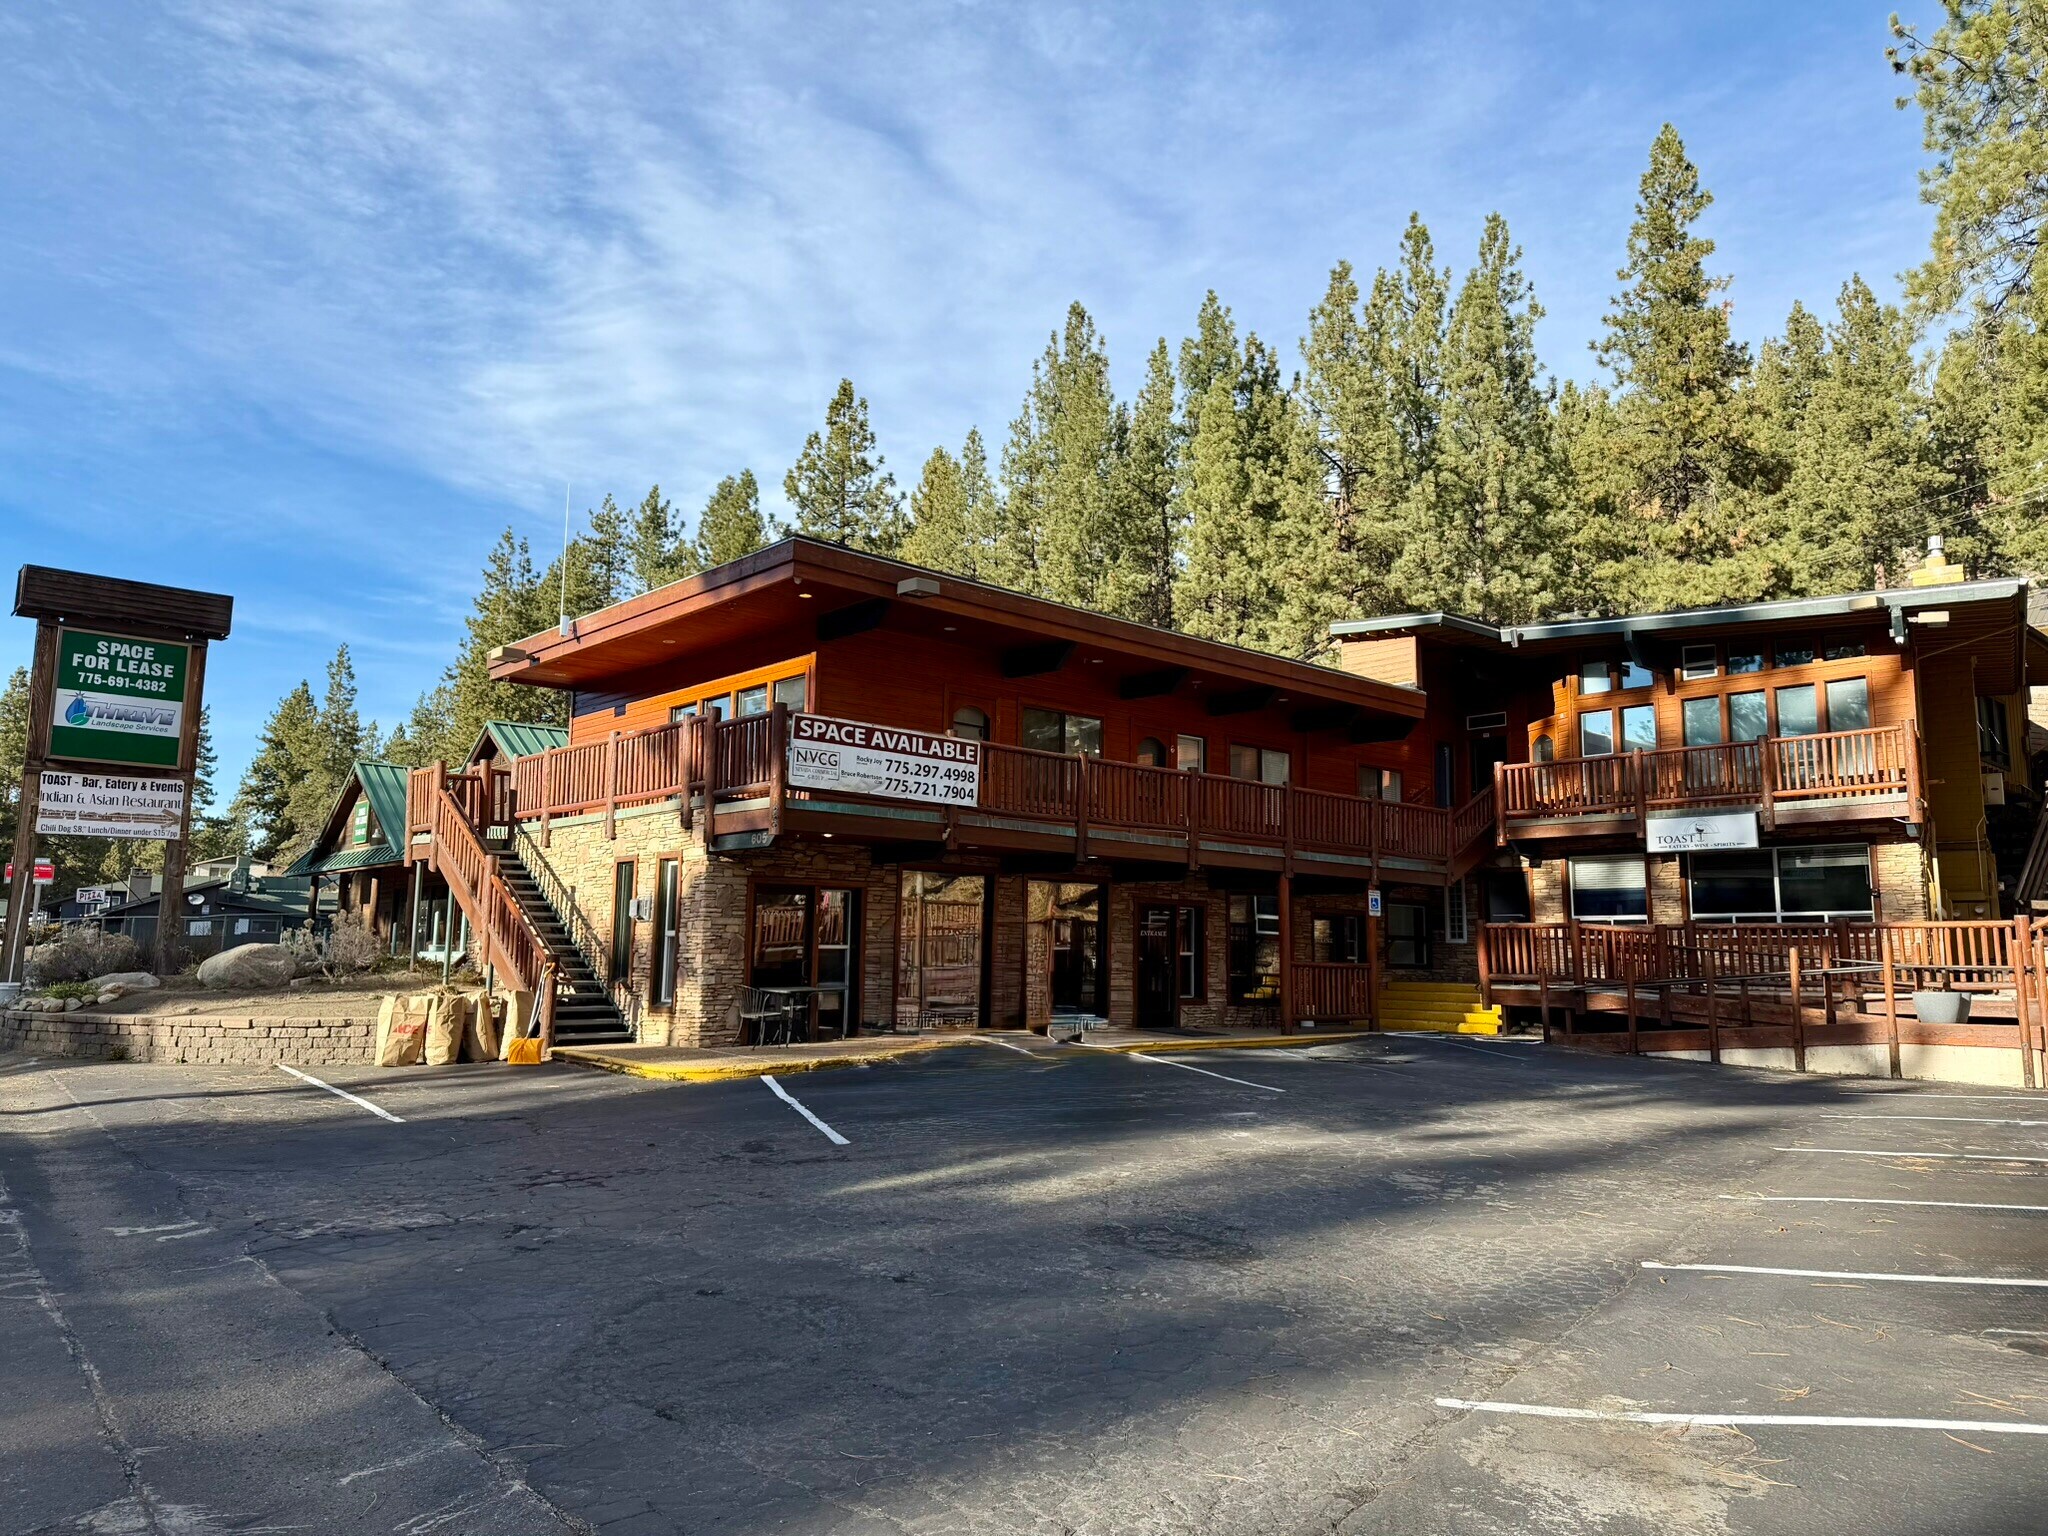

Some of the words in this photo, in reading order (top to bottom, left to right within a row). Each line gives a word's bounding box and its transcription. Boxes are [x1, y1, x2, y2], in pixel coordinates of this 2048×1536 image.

[97, 641, 155, 660] SPACE
[72, 653, 109, 670] FOR
[117, 659, 174, 678] LEASE
[78, 672, 167, 692] 775-691-4382
[85, 701, 176, 726] THRIVE
[91, 720, 134, 730] Landscape
[136, 724, 169, 733] Services
[799, 719, 866, 745] SPACE
[871, 730, 975, 761] AVAILABLE
[796, 749, 838, 767] NVCG
[857, 755, 872, 764] Rocky
[841, 769, 856, 777] Bruce
[857, 772, 883, 780] Robertson
[885, 759, 975, 783] 775.297.4998
[42, 774, 72, 786] TOAST
[82, 776, 102, 789] Bar,
[105, 778, 138, 791] Eatery
[140, 781, 147, 791] &
[150, 781, 184, 793] Events
[885, 777, 975, 800] 775.721.7904
[40, 790, 74, 803] Indian
[76, 792, 86, 805] &
[90, 793, 119, 806] Asian
[122, 795, 182, 809] Restaurant
[40, 823, 57, 832] Chili
[58, 824, 72, 833] Dog
[88, 826, 131, 835] Lunch/Dinner
[1656, 835, 1695, 844] TOAST
[79, 891, 102, 900] PIZZA
